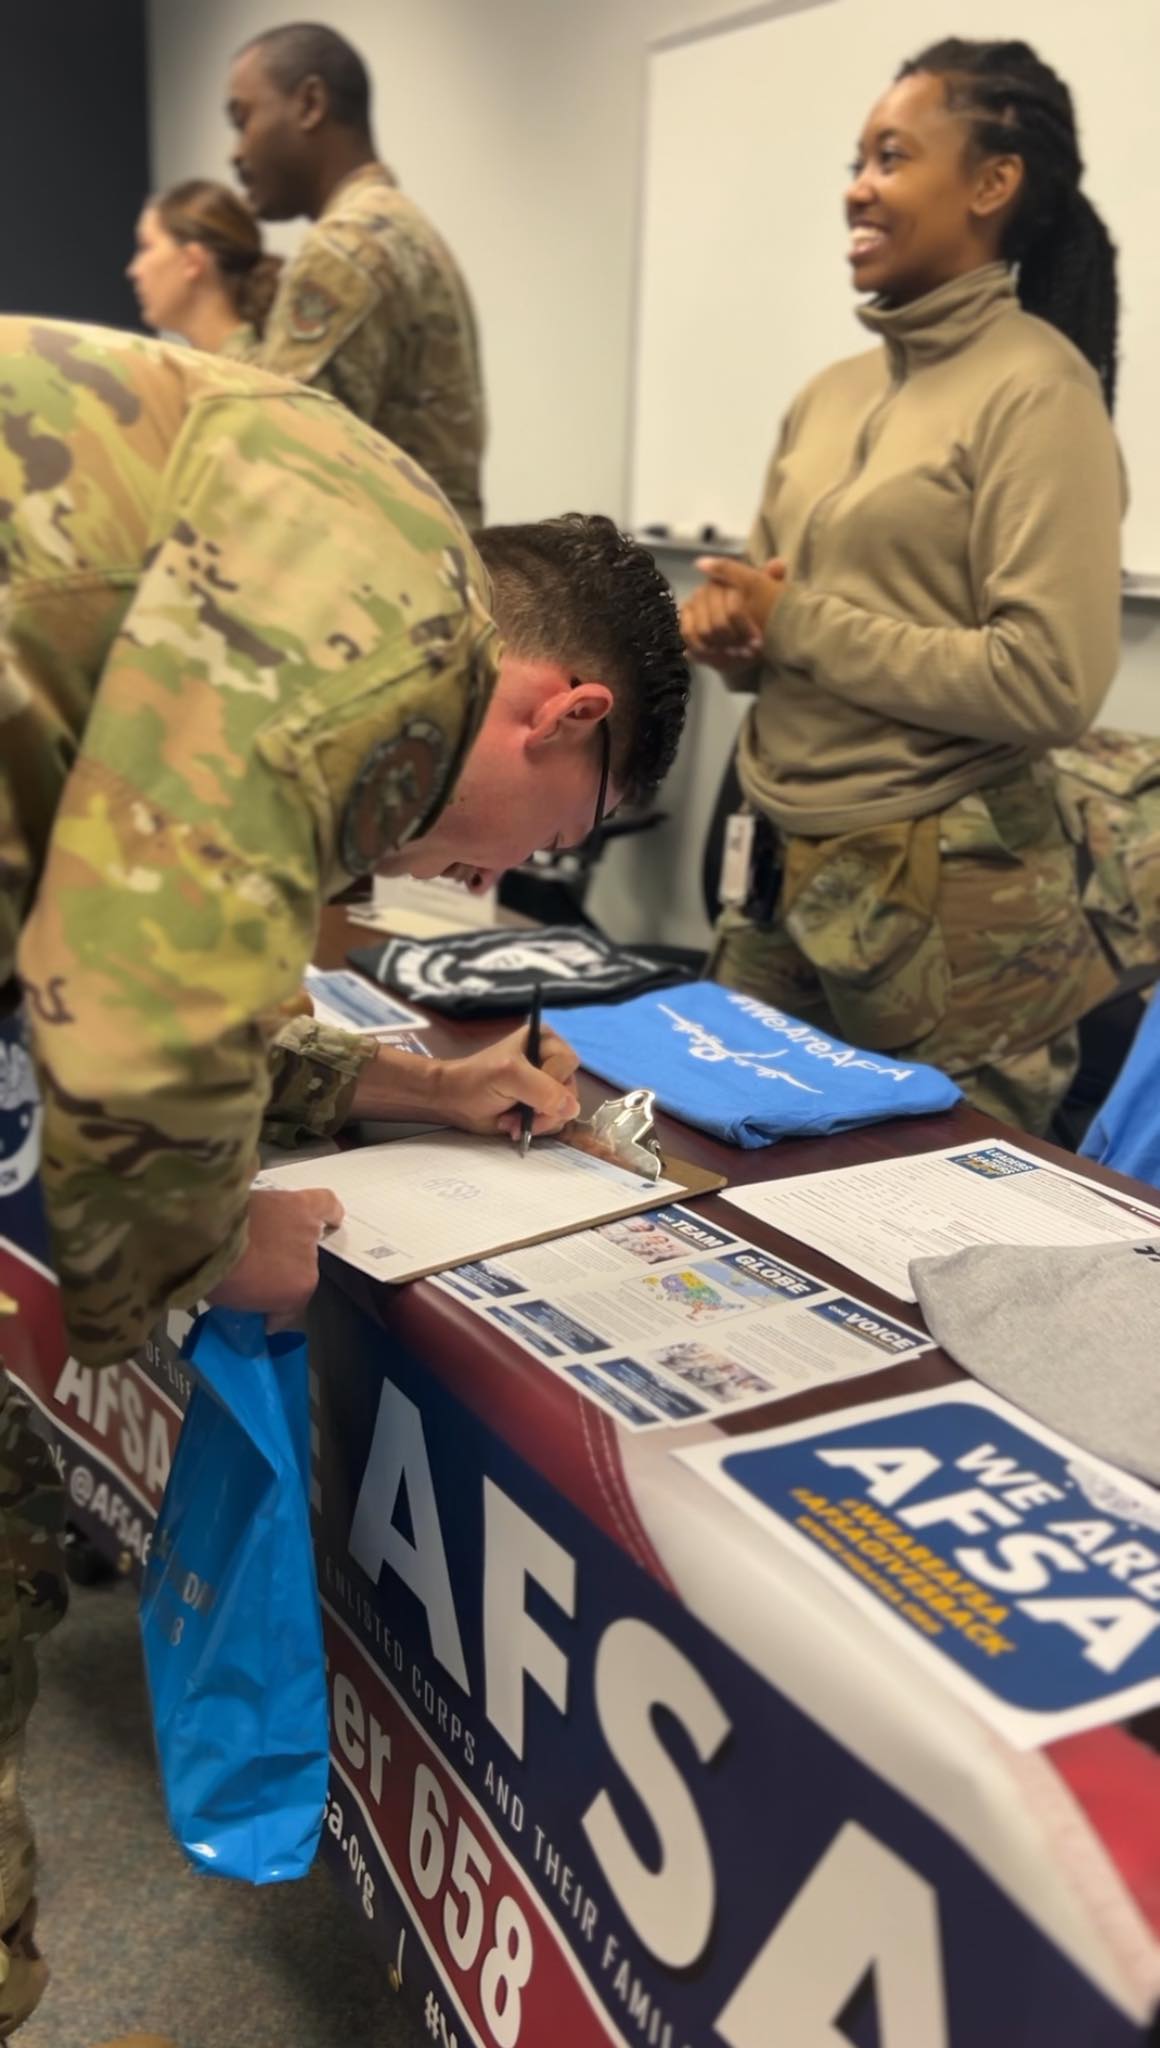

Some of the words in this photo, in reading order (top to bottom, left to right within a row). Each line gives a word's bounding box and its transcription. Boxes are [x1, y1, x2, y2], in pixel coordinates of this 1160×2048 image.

[672, 1219, 725, 1248] TEAM
[735, 1254, 811, 1295] GLOBE
[845, 1312, 917, 1350] VOICE
[954, 1443, 1066, 1511] WE
[813, 1448, 1160, 1674] AFSA
[348, 1376, 953, 2048] AFSA
[411, 1663, 476, 1766] CORPS
[484, 1760, 525, 1833] AND
[534, 1823, 599, 1943] THEIR
[408, 1762, 534, 2048] 658
